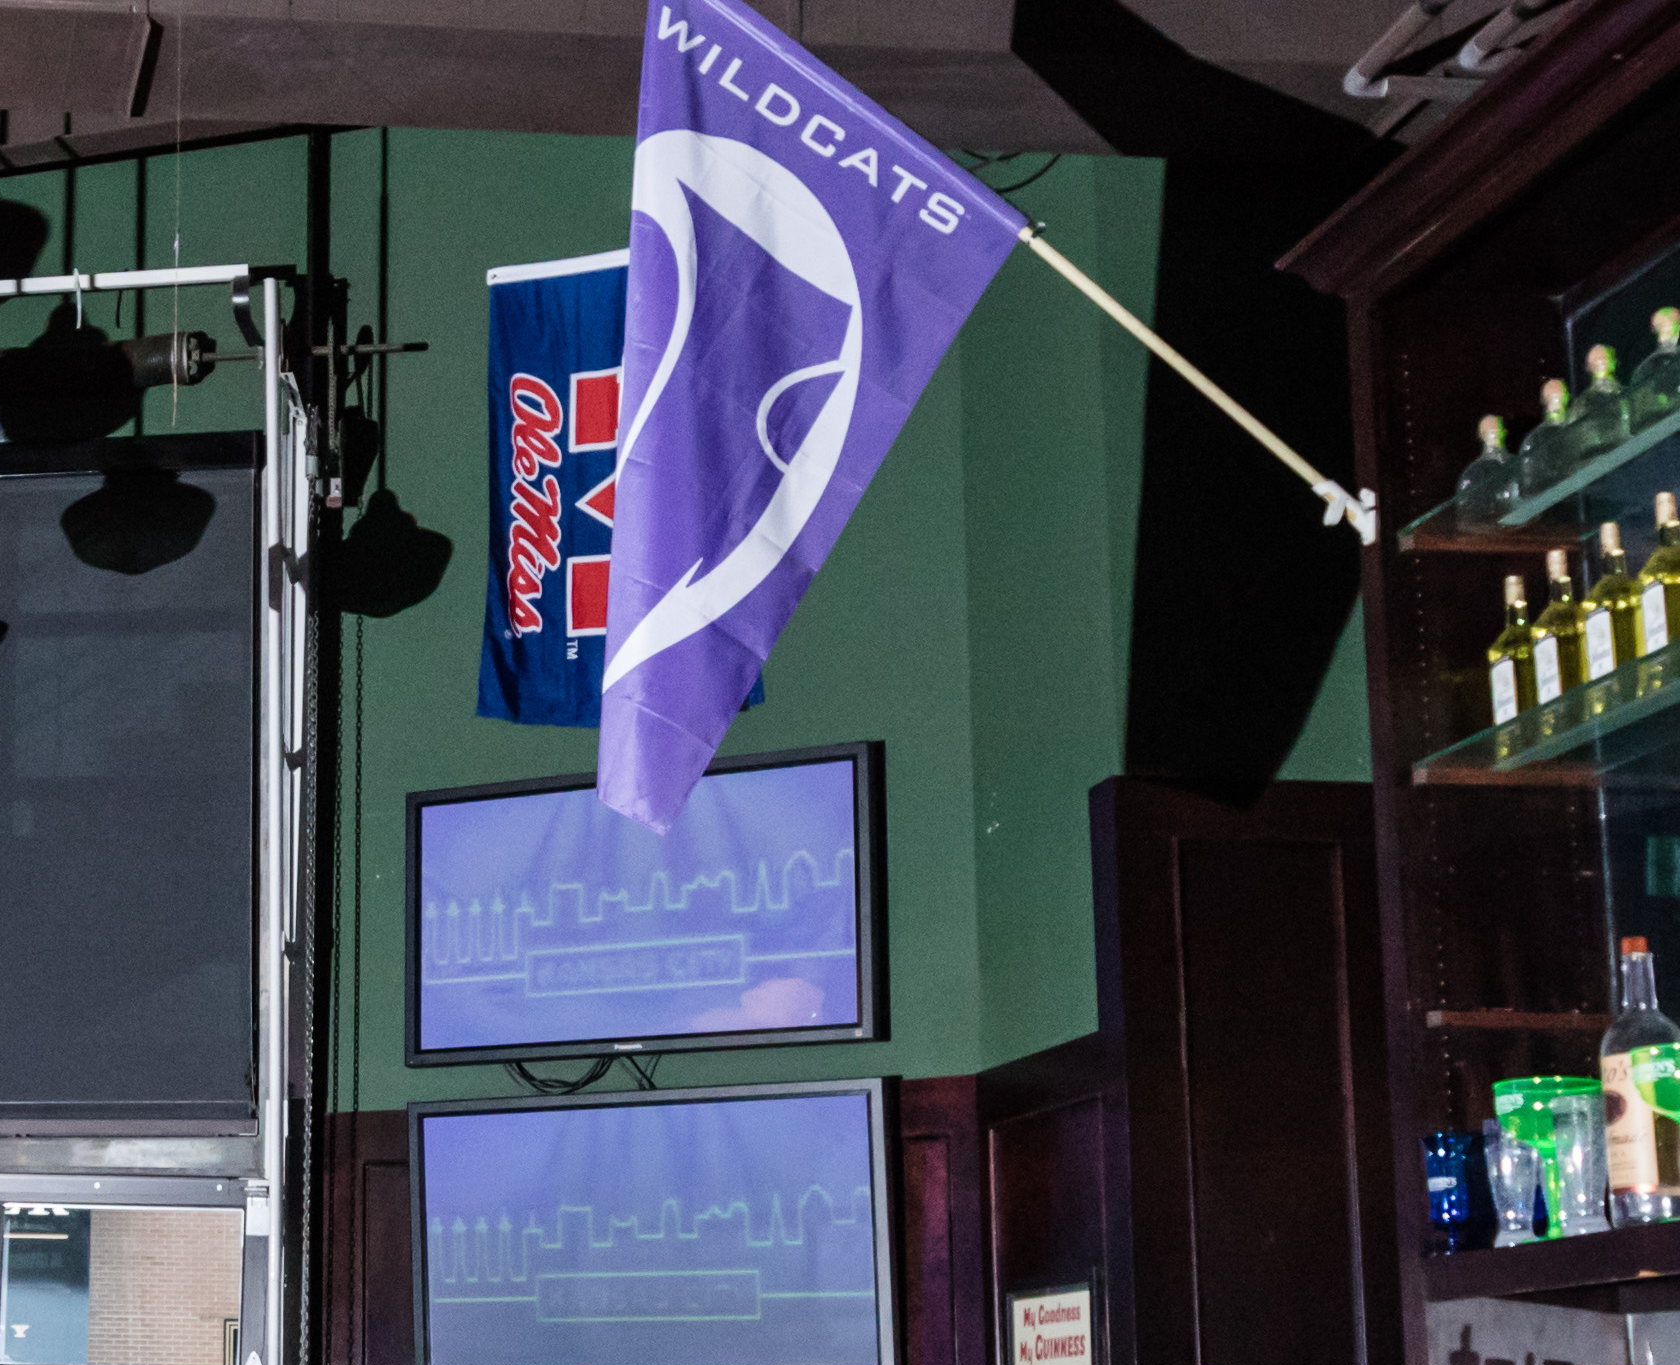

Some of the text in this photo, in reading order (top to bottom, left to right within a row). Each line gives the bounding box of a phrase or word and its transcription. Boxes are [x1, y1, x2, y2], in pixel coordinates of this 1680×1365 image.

[656, 5, 964, 237] WILDCATS
[508, 373, 563, 637] Ole Miss
[1019, 1332, 1087, 1365] My GUINNESS
[1023, 1302, 1081, 1332] My Goodness
